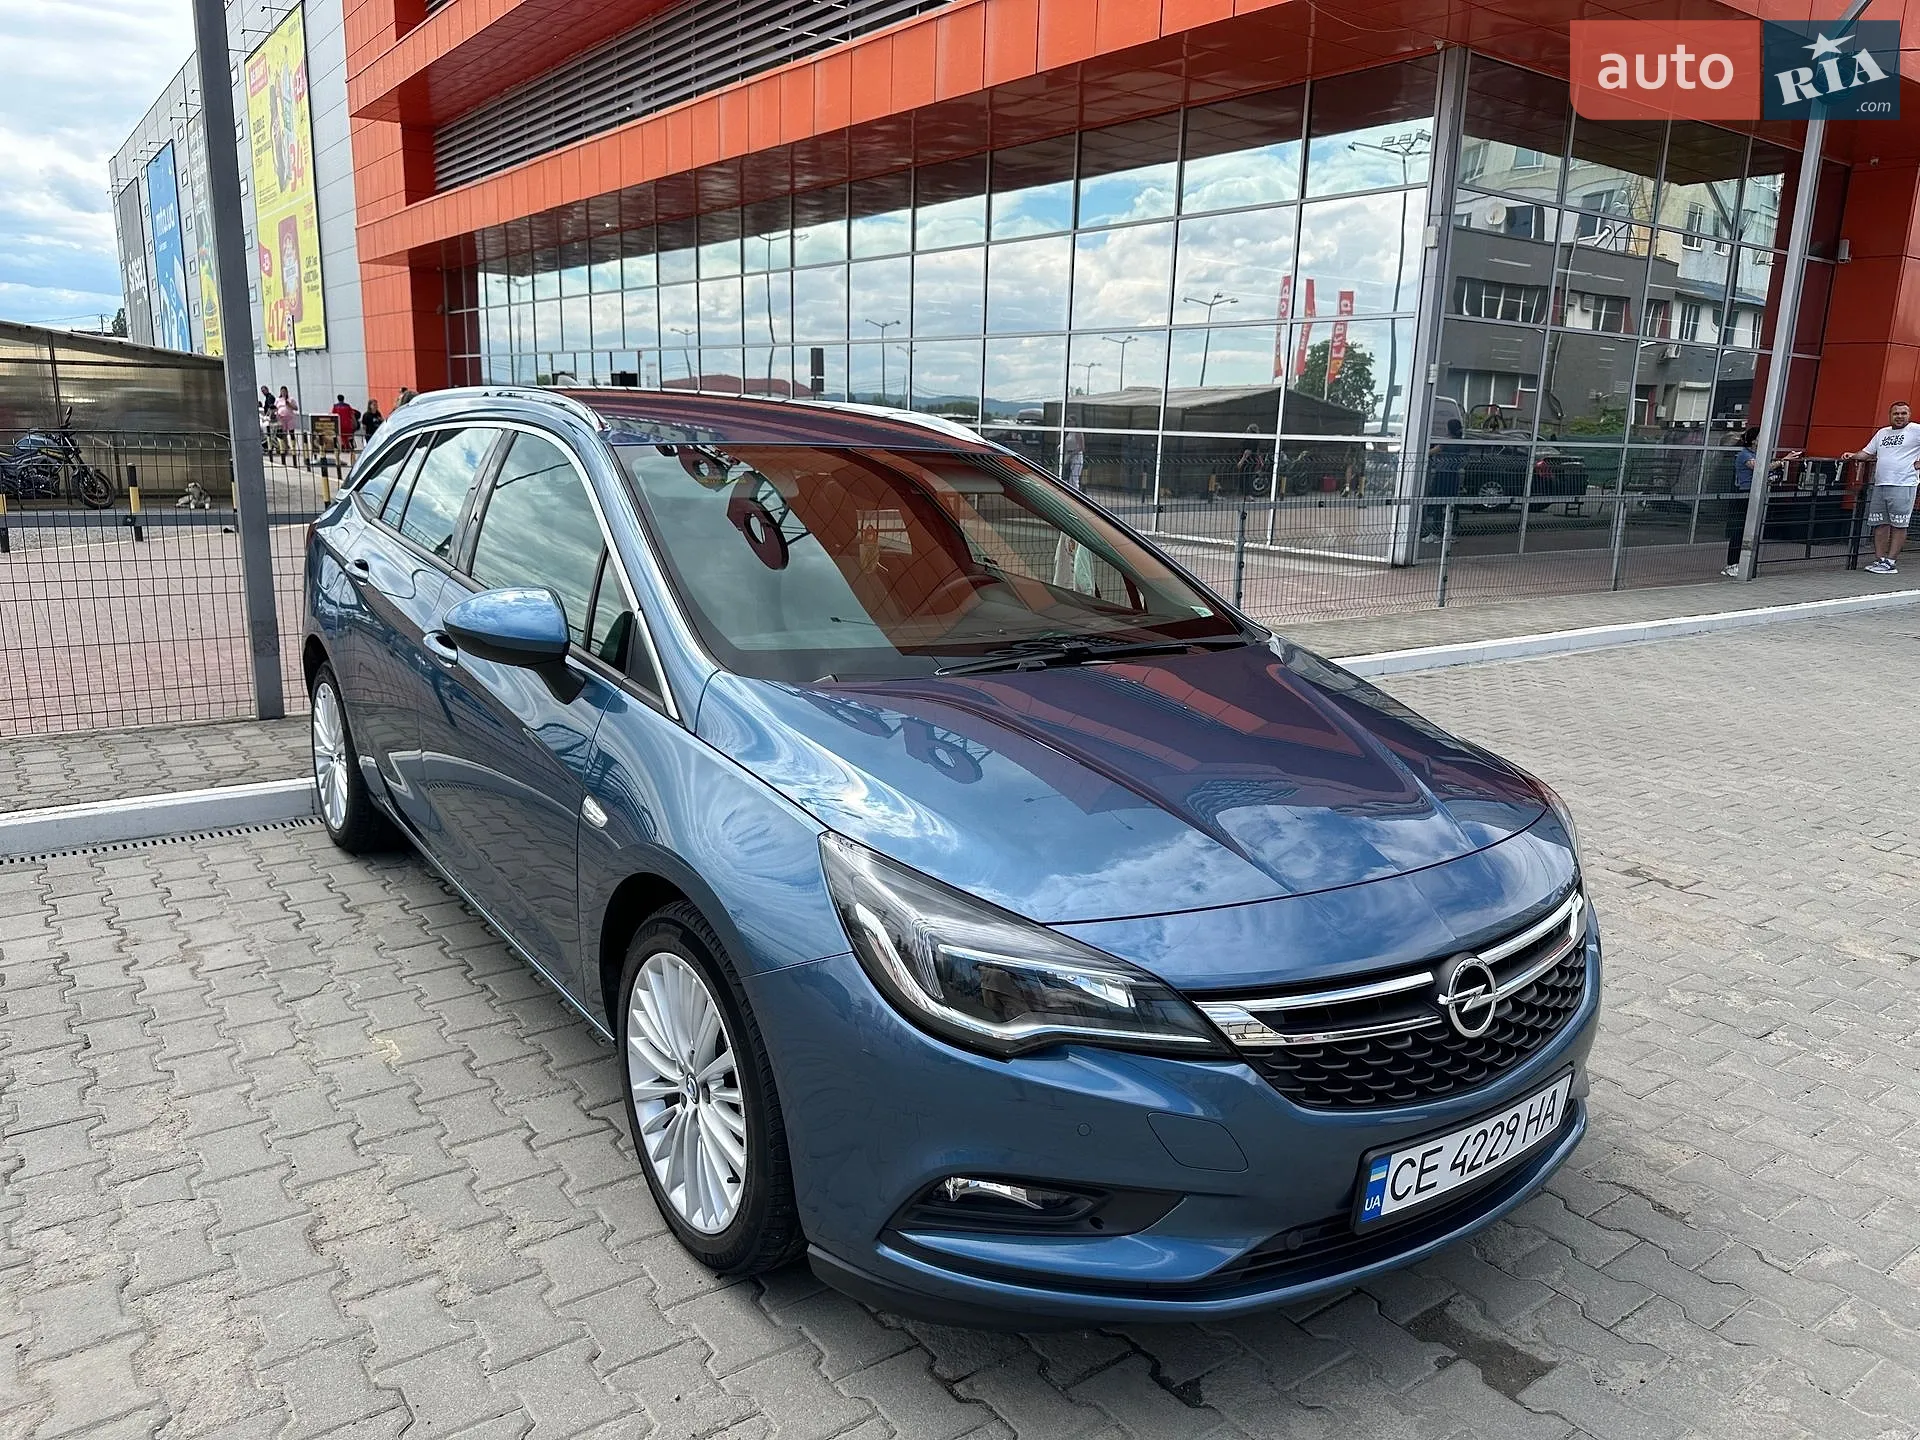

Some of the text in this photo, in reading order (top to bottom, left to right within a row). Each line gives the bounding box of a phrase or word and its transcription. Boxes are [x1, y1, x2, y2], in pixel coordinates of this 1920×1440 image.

[1390, 1089, 1559, 1201] CE 4229 HA
[1364, 1194, 1381, 1211] UA
